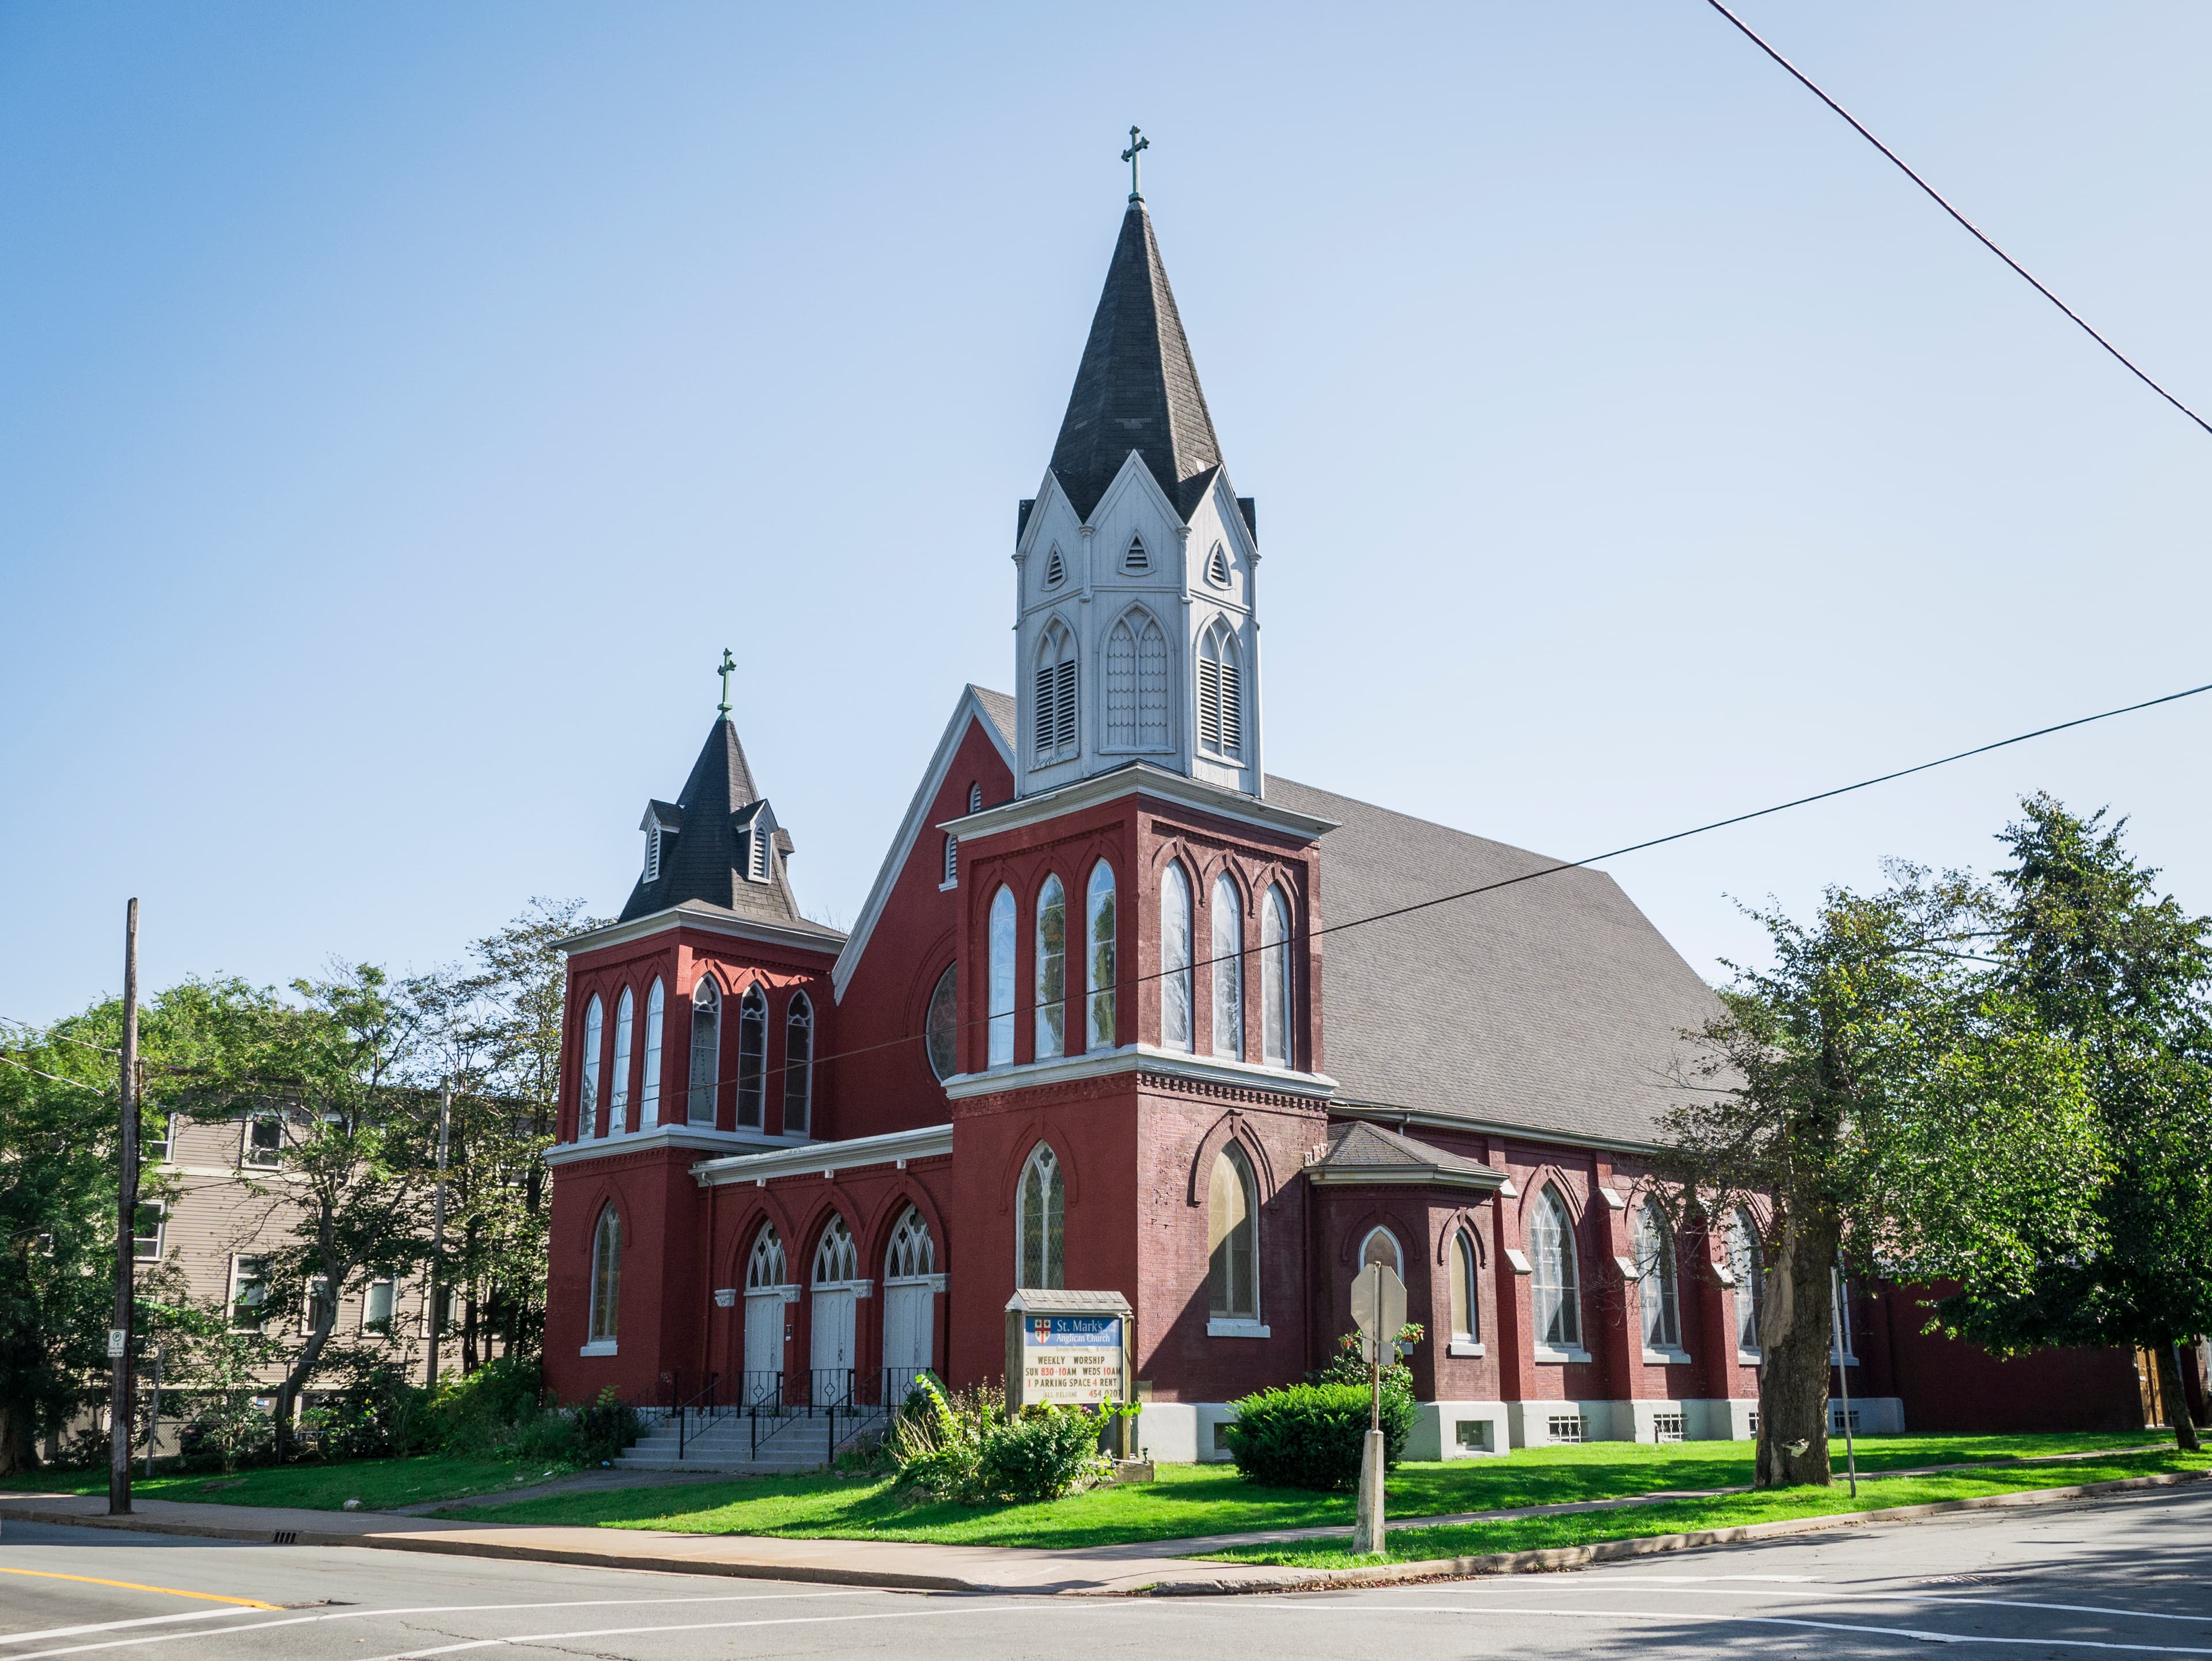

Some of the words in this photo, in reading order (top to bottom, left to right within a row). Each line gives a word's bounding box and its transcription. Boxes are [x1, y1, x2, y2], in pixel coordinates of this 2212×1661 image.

[1057, 1319, 1069, 1332] St.
[1073, 1320, 1103, 1332] Mark's
[1056, 1334, 1085, 1344] Anglican
[1086, 1333, 1110, 1342] Church
[1038, 1356, 1065, 1364] WEEKLY
[1074, 1356, 1105, 1364] WORSHIP
[1025, 1368, 1039, 1376] SUN
[1083, 1367, 1101, 1375] WEDS
[1104, 1367, 1121, 1375] 10AM
[1069, 1379, 1091, 1387] SPACE
[1100, 1378, 1117, 1386] RENT
[1089, 1390, 1102, 1398] 454
[1105, 1389, 1122, 1398] 0207
